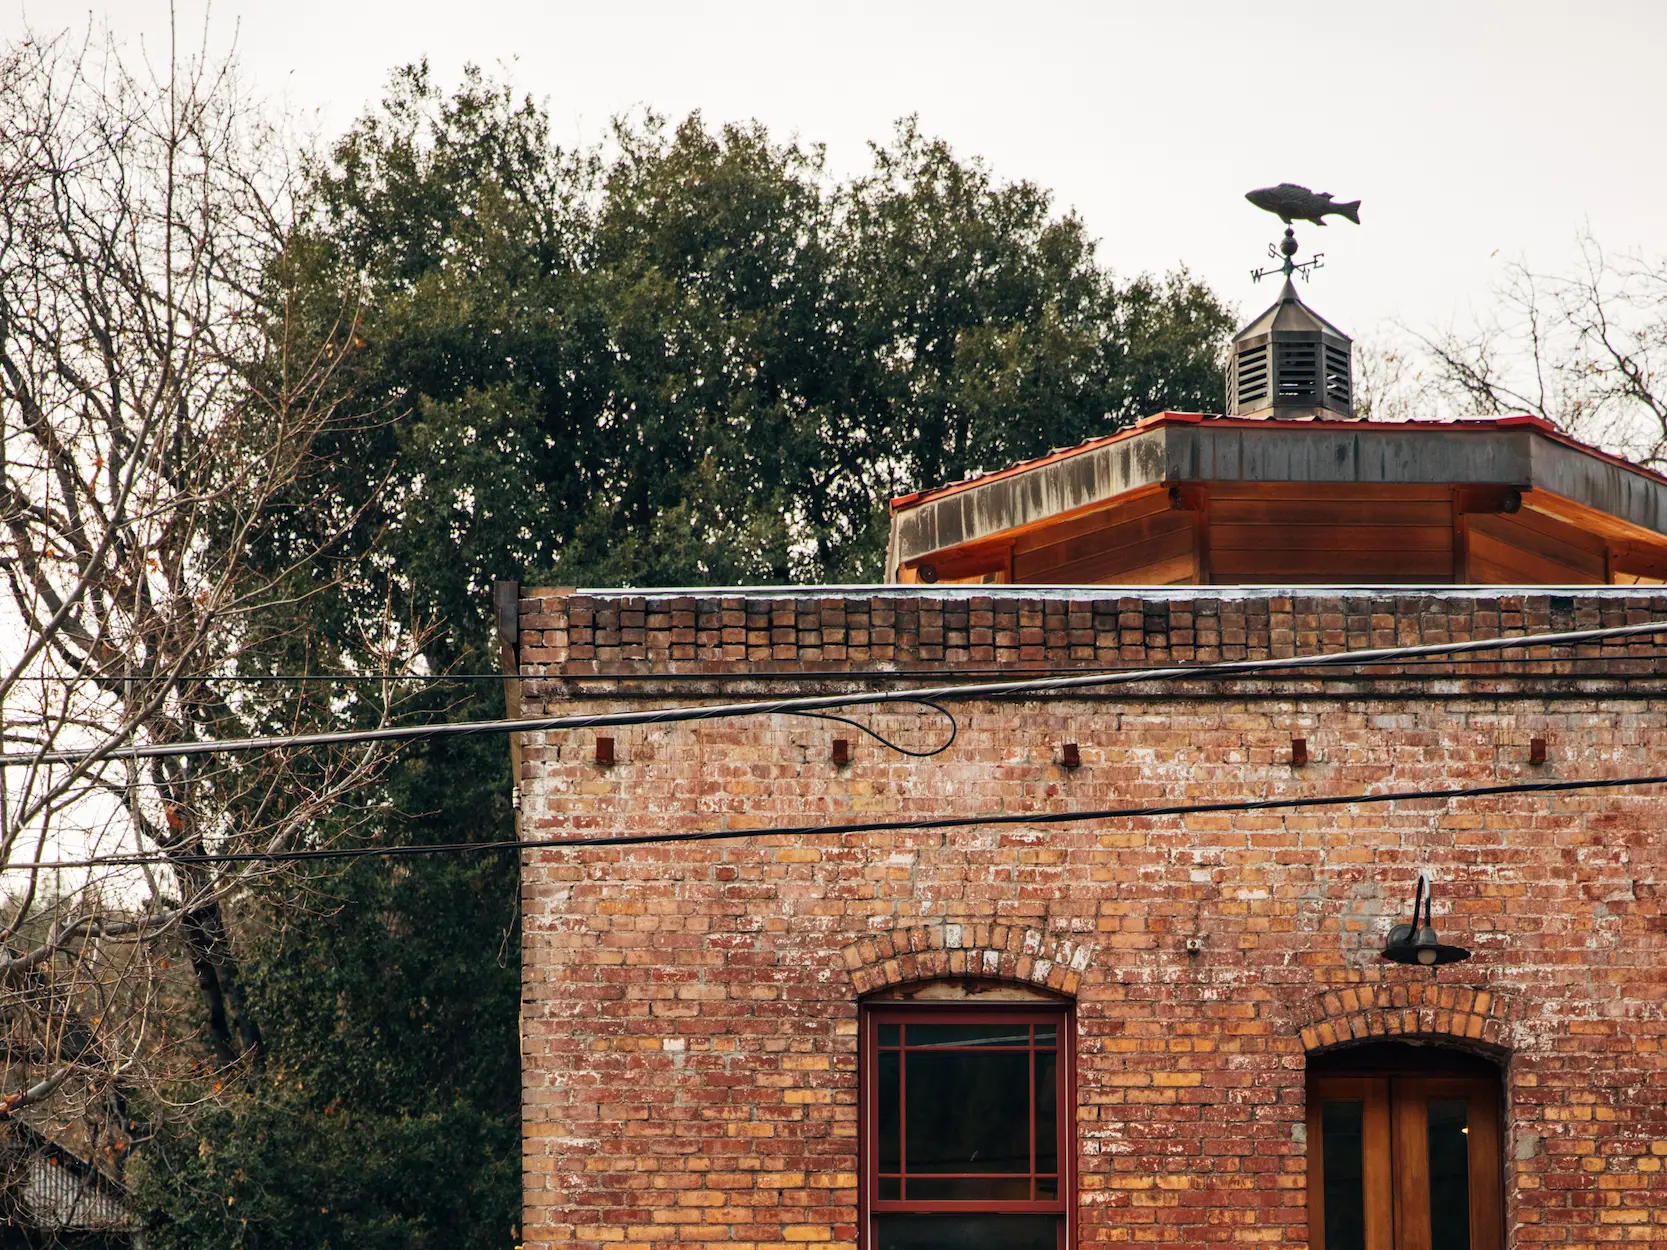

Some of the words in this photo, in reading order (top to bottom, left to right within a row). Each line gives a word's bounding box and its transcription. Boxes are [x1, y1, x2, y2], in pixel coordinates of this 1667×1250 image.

[1268, 242, 1277, 258] S
[1312, 253, 1325, 269] E
[1250, 267, 1264, 284] W
